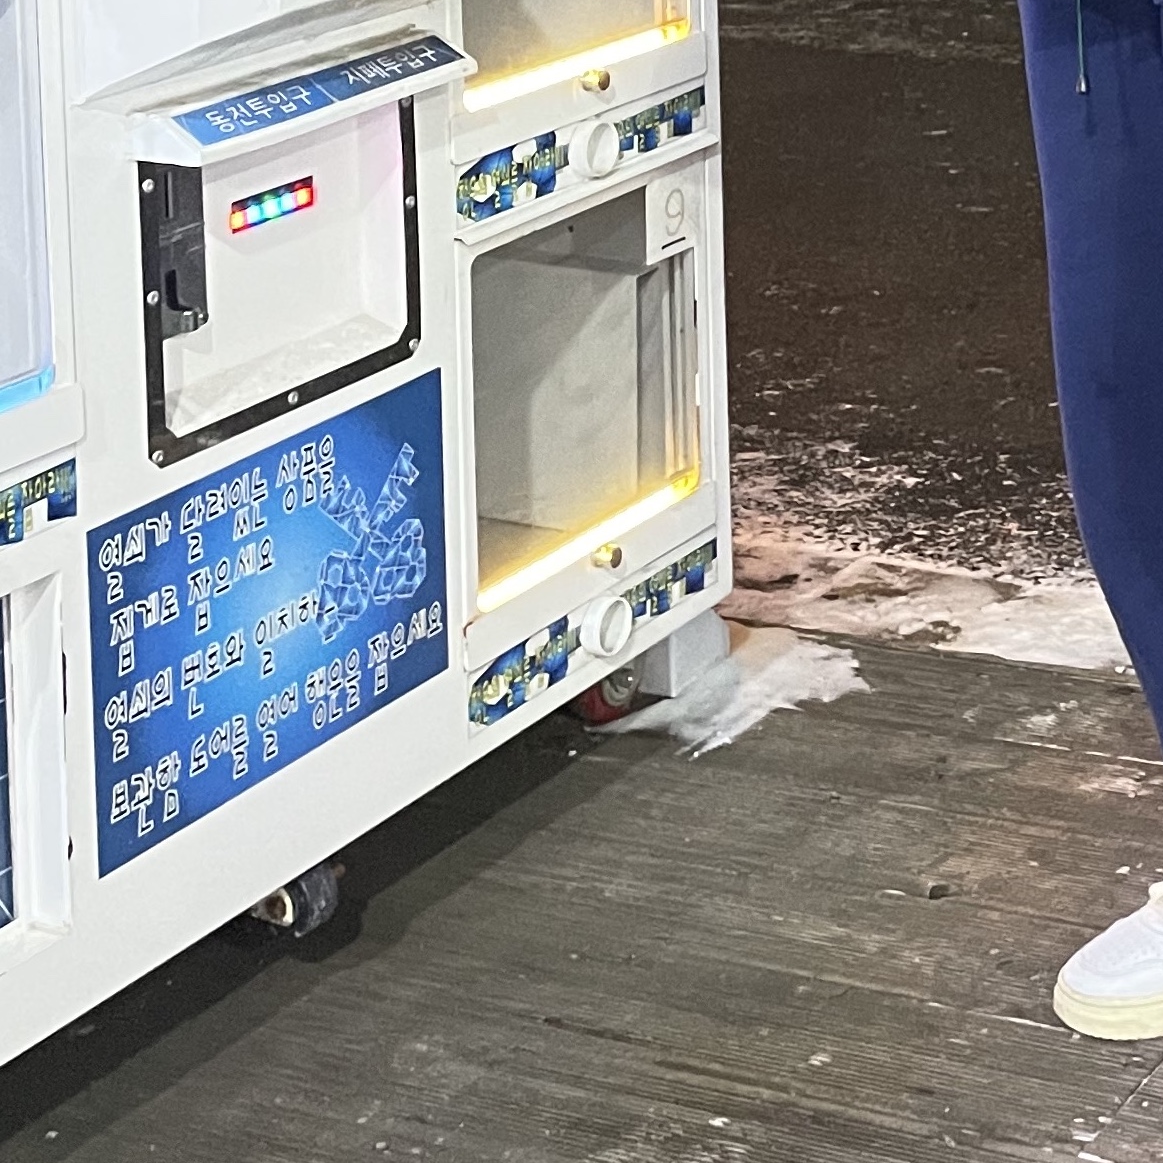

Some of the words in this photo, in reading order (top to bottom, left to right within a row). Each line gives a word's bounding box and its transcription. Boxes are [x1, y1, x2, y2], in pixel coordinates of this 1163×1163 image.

[205, 84, 313, 133] 동전투입구
[340, 43, 438, 86] 지폐투입구
[664, 188, 685, 237] 9
[98, 511, 172, 604] 열쇠가
[180, 467, 268, 563] 달려있는
[275, 434, 336, 514] 상품을
[109, 585, 180, 677] 집게로
[187, 535, 276, 636] 잡으세요
[104, 667, 174, 763] 열쇠의
[181, 629, 246, 720] 번호와
[110, 751, 182, 837] 보관함
[189, 714, 250, 781] 도어를
[256, 682, 298, 762] 열어
[305, 648, 362, 730] 행운을
[367, 601, 444, 696] 잡으세요
